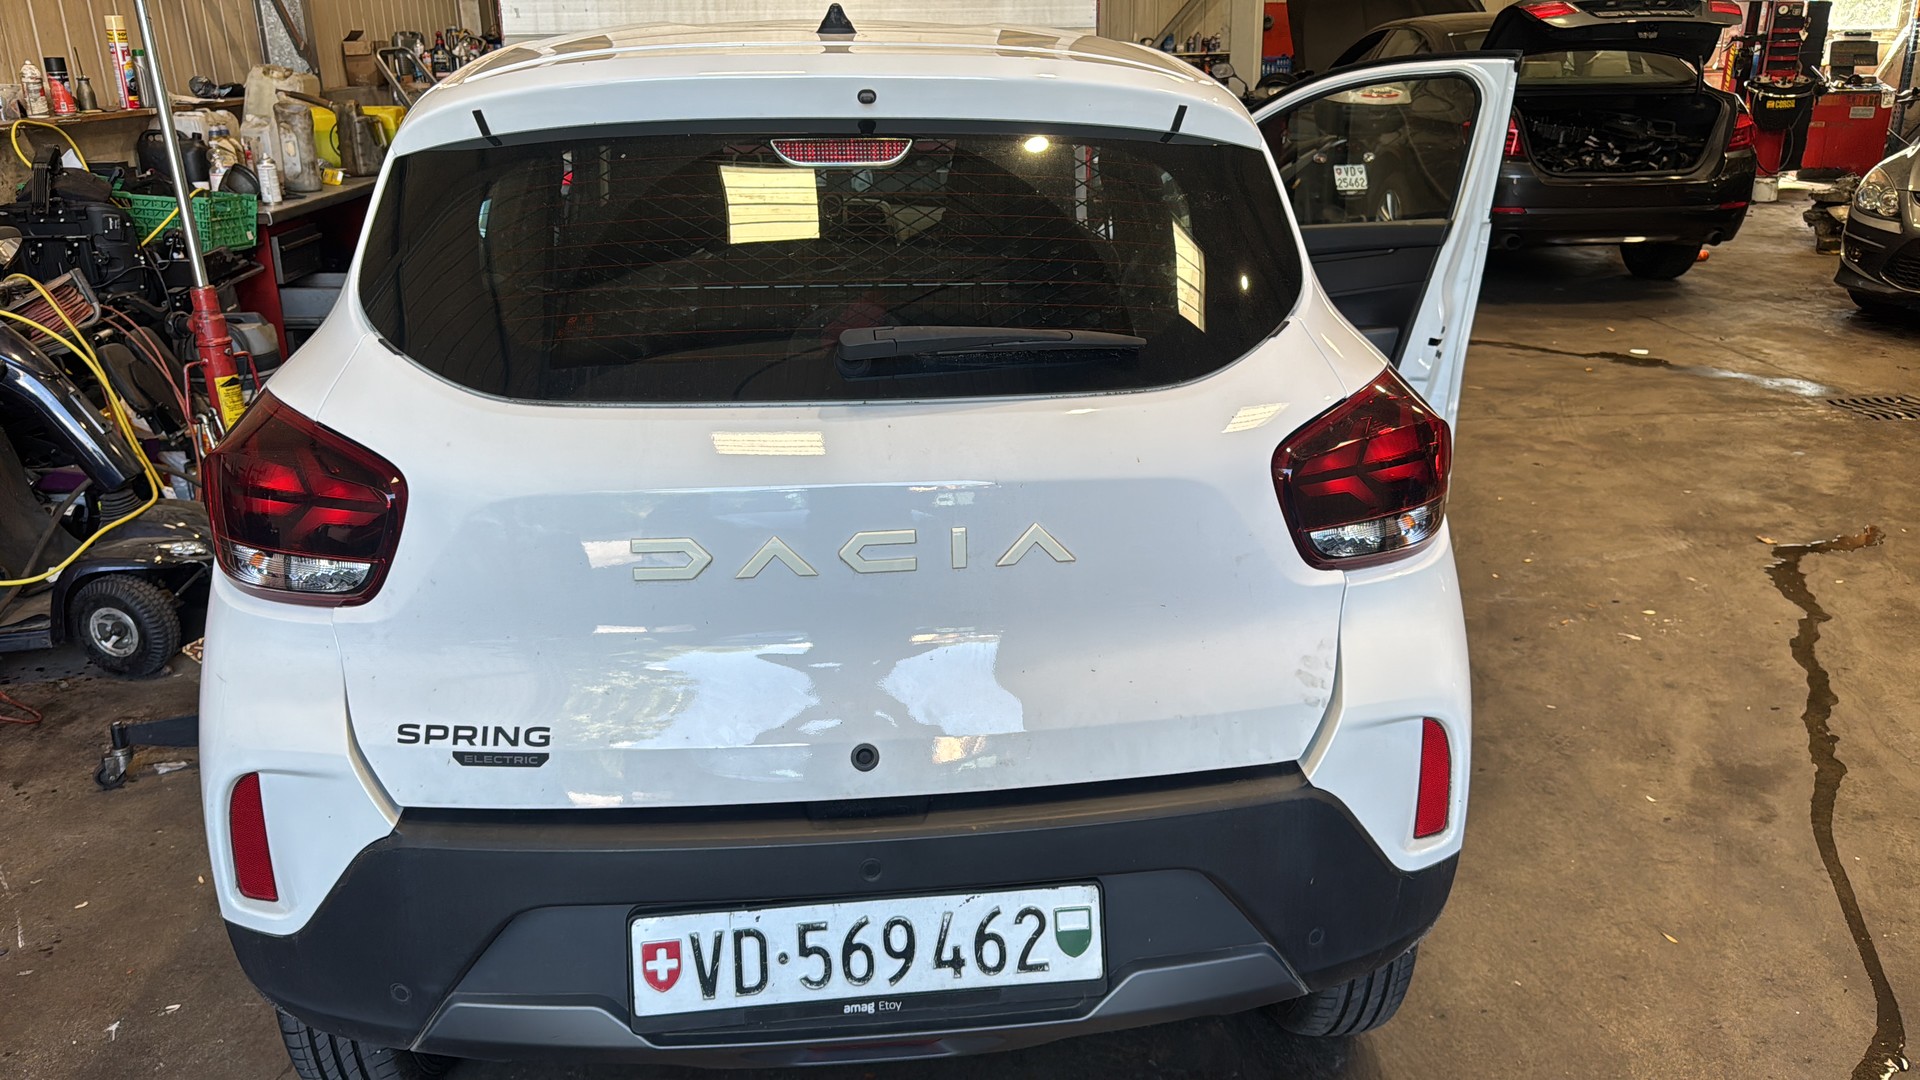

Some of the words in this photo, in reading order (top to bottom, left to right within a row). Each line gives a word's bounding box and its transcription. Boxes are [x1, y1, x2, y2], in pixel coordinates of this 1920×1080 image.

[1343, 166, 1356, 177] VD
[1337, 177, 1366, 188] 25462
[630, 522, 1077, 581] DACIA
[397, 723, 551, 747] SPRING
[464, 754, 539, 765] ELECTRIC
[843, 1002, 875, 1014] amag
[878, 1001, 902, 1011] Etoy
